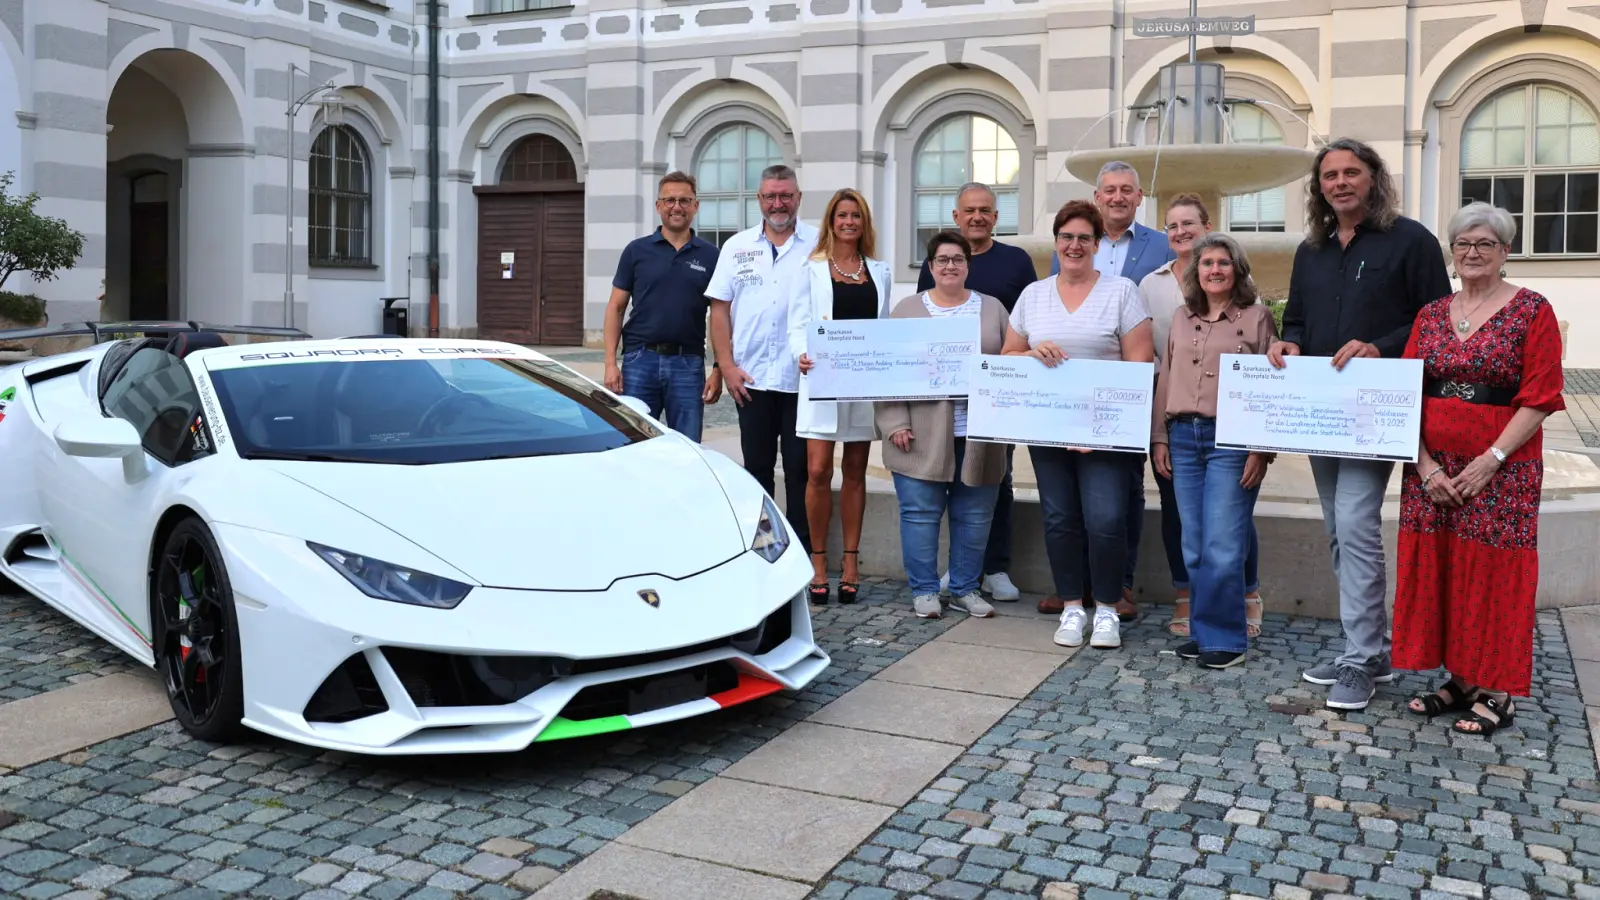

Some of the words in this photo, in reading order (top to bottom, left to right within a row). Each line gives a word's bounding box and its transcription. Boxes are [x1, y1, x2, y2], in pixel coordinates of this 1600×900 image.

[1137, 20, 1250, 33] JERUSALEMWEG
[240, 348, 404, 361] SQUADRA
[418, 347, 516, 355] CORSE
[990, 364, 1016, 372] Sparkasse
[1243, 365, 1272, 373] Sparkasse
[990, 371, 1014, 380] Oberpfalz
